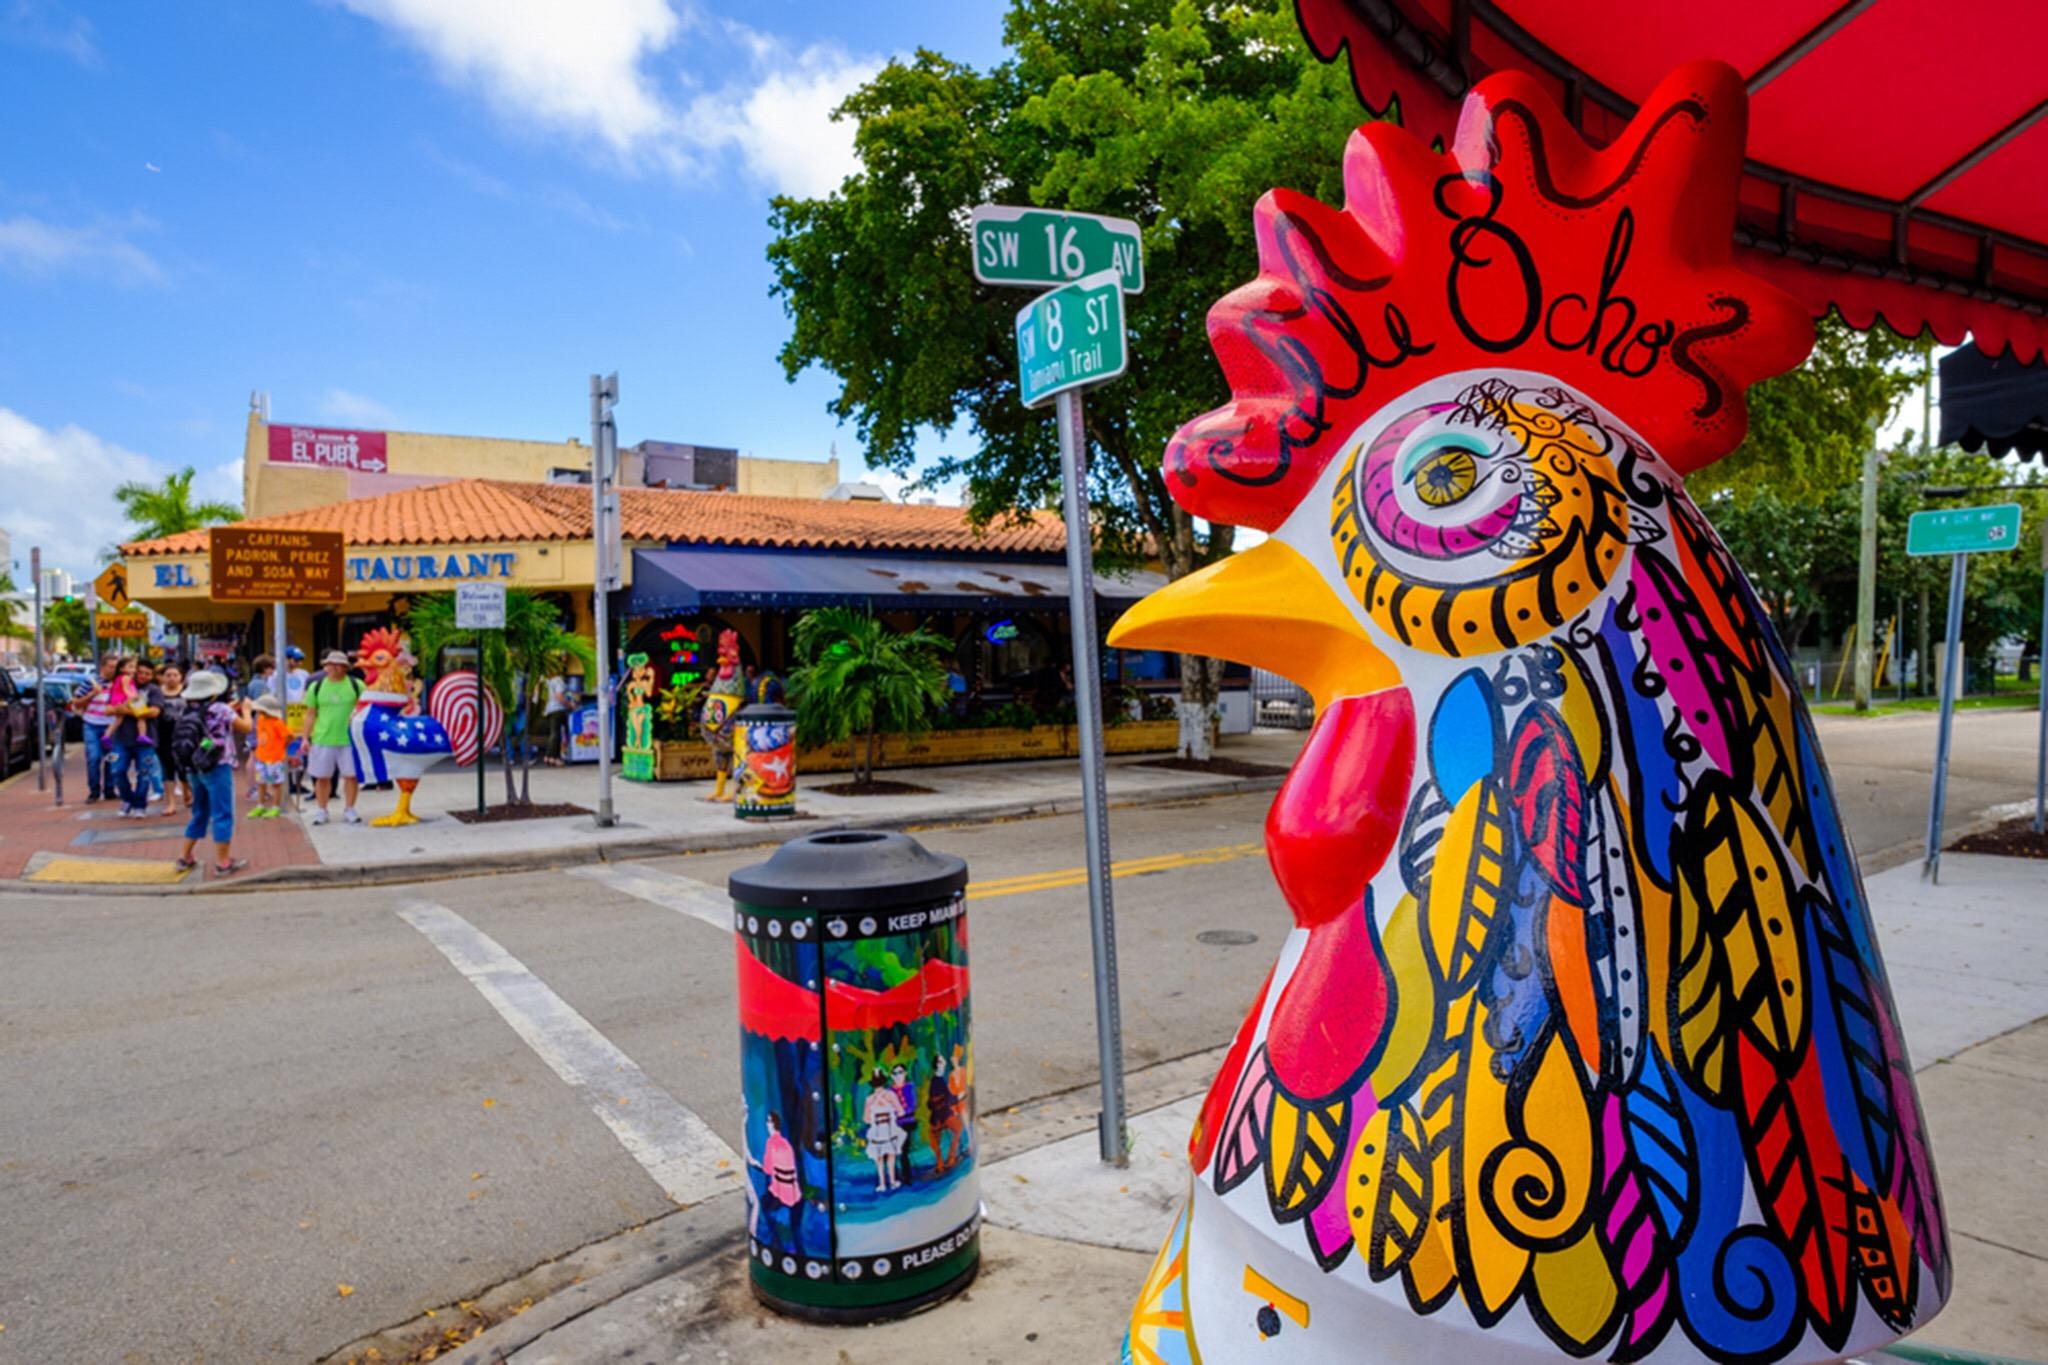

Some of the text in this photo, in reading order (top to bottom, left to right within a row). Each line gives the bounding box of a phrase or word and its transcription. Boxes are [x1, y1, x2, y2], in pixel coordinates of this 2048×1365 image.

[982, 223, 1134, 277] SW 16 AV
[1434, 171, 1675, 378] Ocho
[1046, 298, 1063, 352] 8
[1085, 294, 1109, 336] ST
[1069, 342, 1102, 376] Trail
[292, 441, 312, 462] EL
[153, 552, 515, 588] EL TAURANT
[226, 564, 330, 579] AND SOSA WAY
[289, 549, 330, 564] PEREZ
[97, 619, 146, 631] AHEAD
[888, 912, 927, 932] KEEP
[902, 1238, 956, 1270] PLEASE
